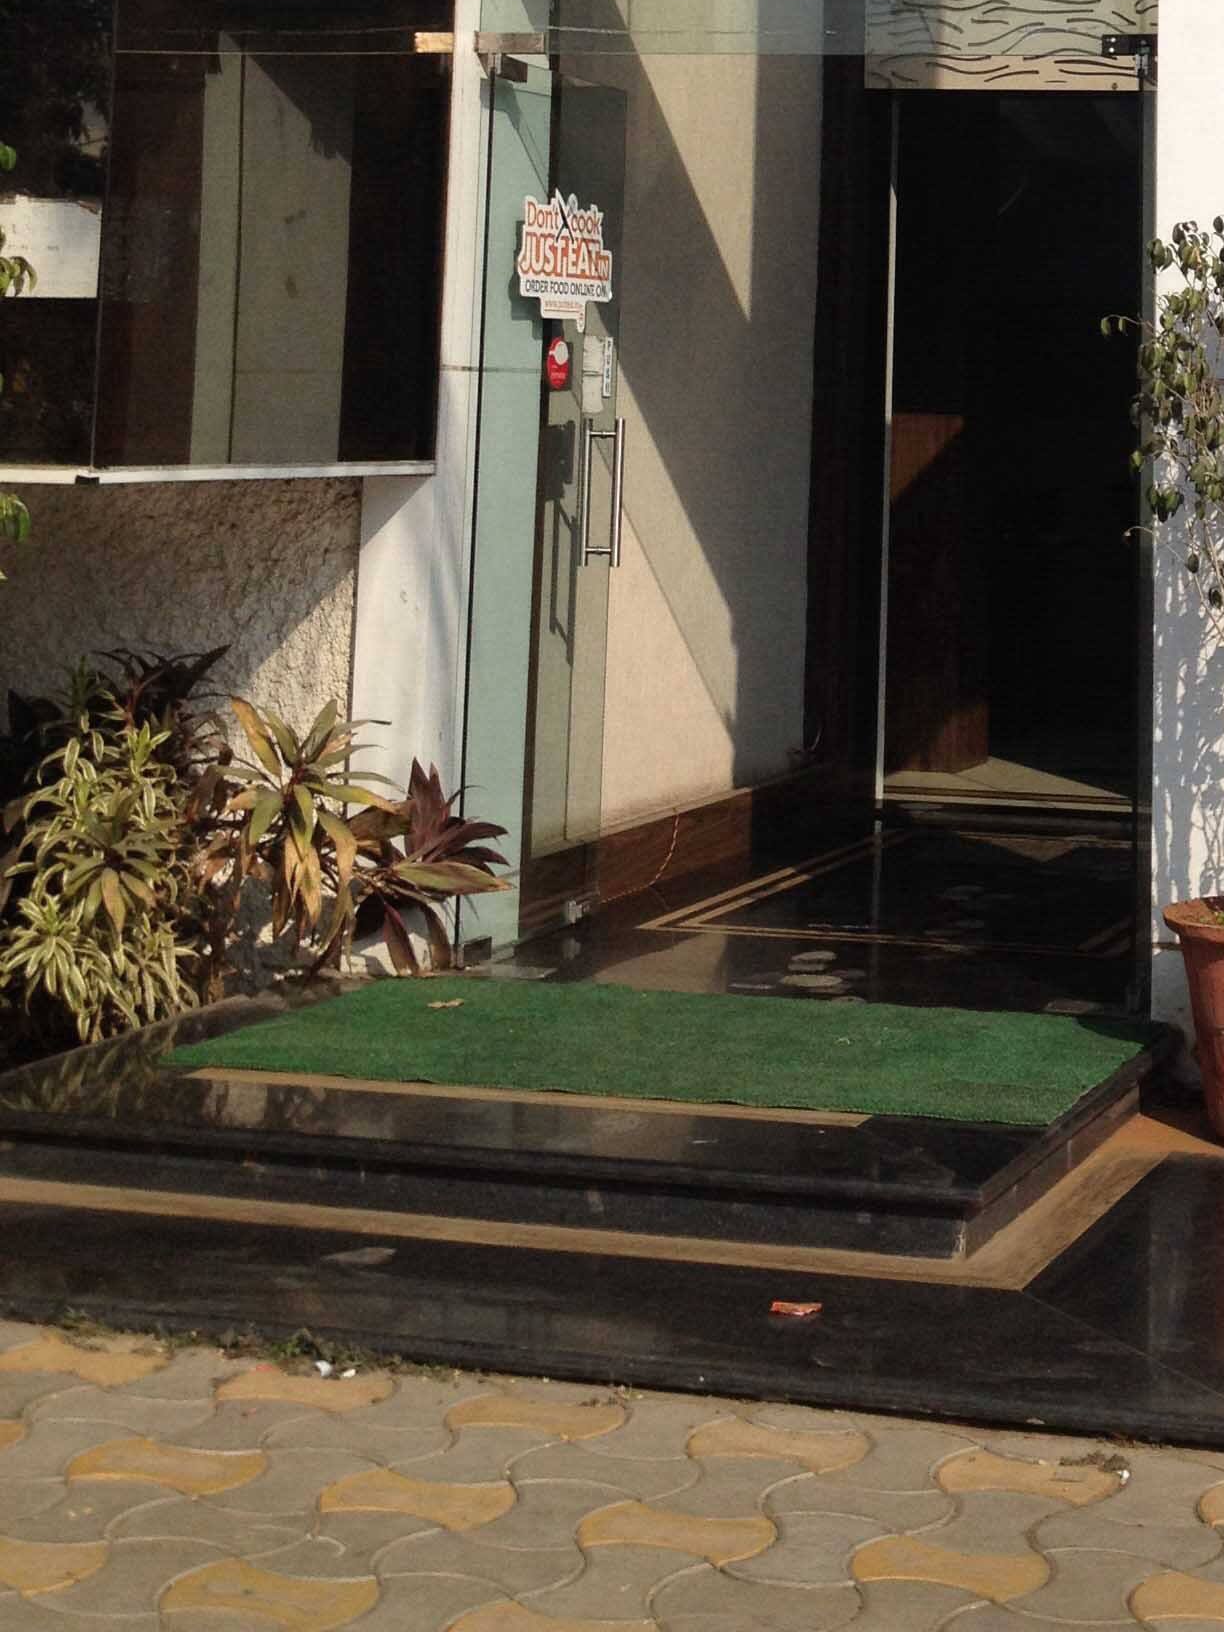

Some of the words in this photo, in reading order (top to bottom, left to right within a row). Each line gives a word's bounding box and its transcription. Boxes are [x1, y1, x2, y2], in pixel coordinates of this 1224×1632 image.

[570, 210, 602, 235] cook
[520, 233, 566, 273] JUST
[525, 279, 549, 294] ORDER
[549, 280, 569, 295] FOOD
[570, 282, 595, 297] ONLINE
